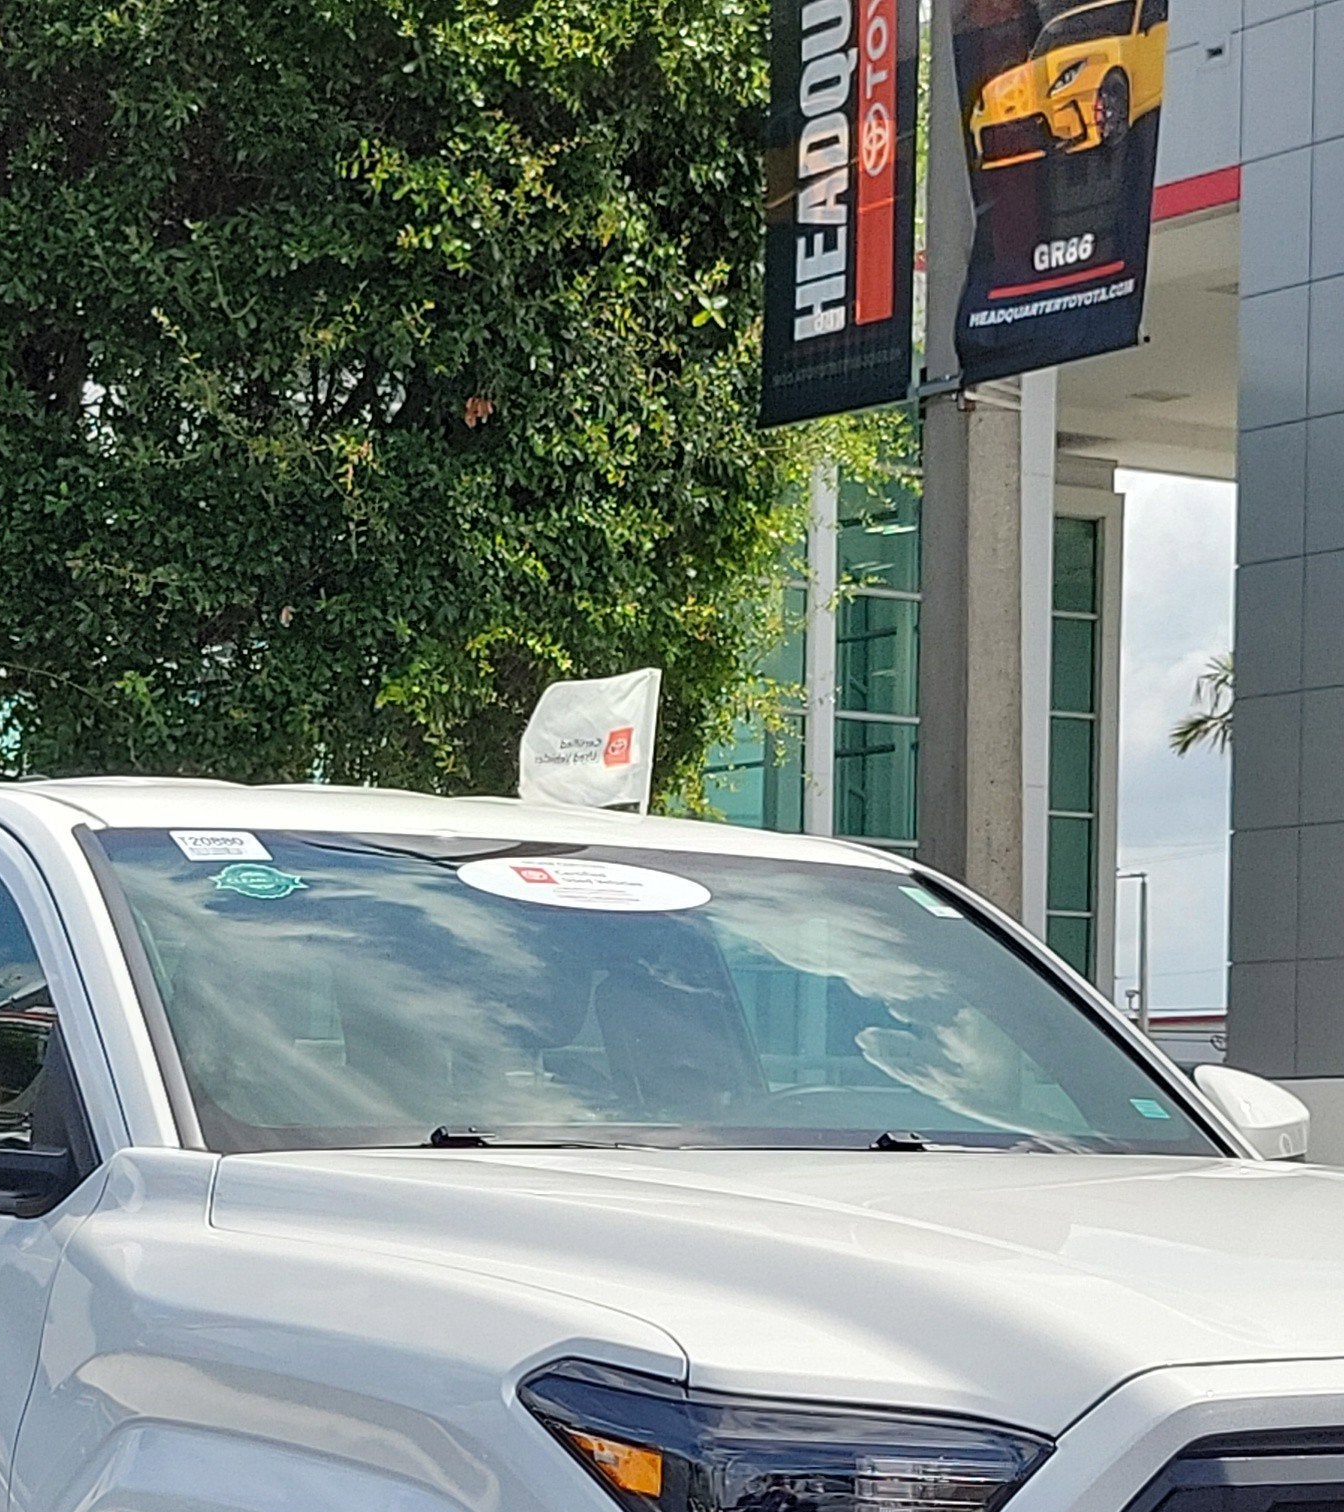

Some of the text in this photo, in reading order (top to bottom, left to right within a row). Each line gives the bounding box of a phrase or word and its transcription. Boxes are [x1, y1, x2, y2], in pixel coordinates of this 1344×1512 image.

[794, 0, 858, 341] HEADQU
[1033, 233, 1095, 271] GR86
[969, 278, 1136, 328] HEADQUARTERTOYOTA.COM
